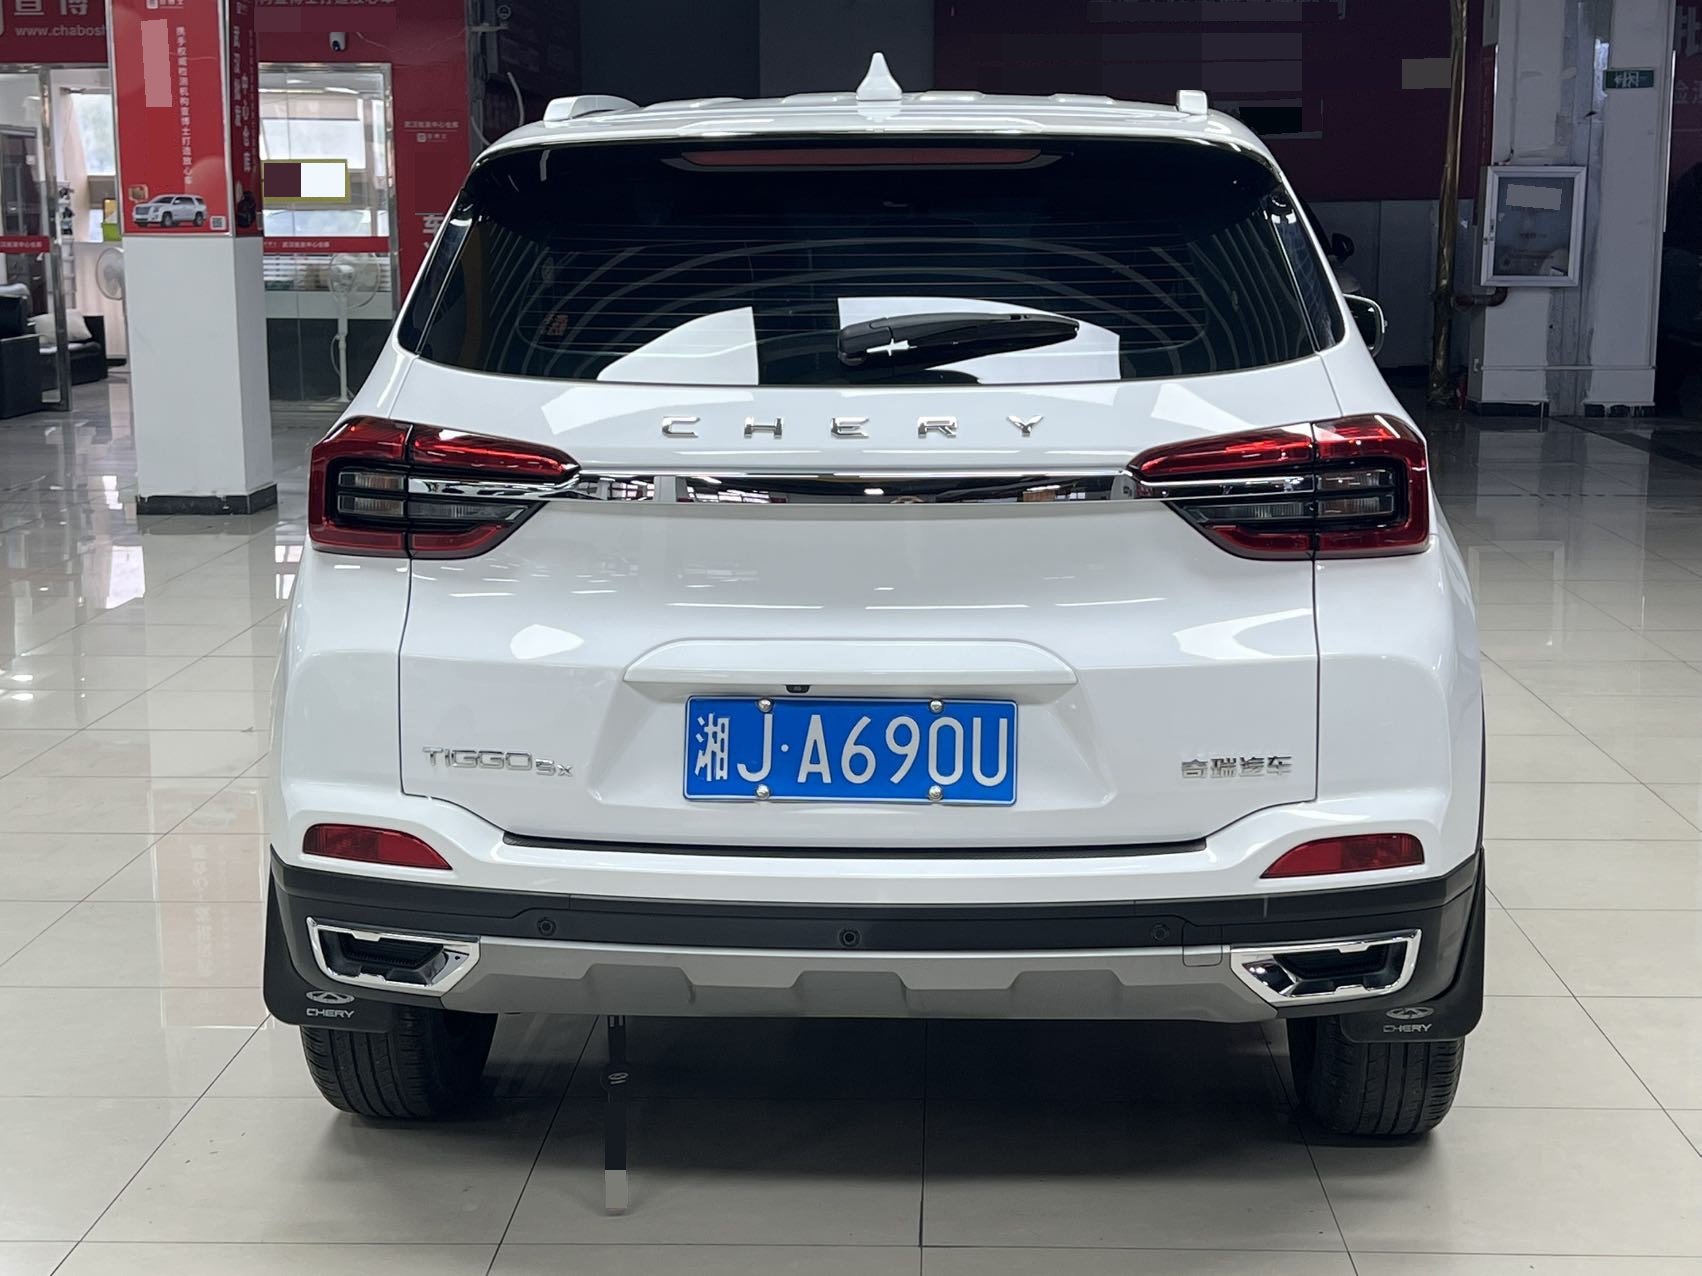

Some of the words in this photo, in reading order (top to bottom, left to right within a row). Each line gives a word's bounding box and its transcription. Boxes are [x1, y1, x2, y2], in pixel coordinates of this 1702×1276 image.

[661, 415, 1045, 439] CHERY
[1181, 756, 1292, 779] 奇瑞汽车
[306, 1008, 355, 1018] CHERY
[1383, 1023, 1433, 1033] CHERY
